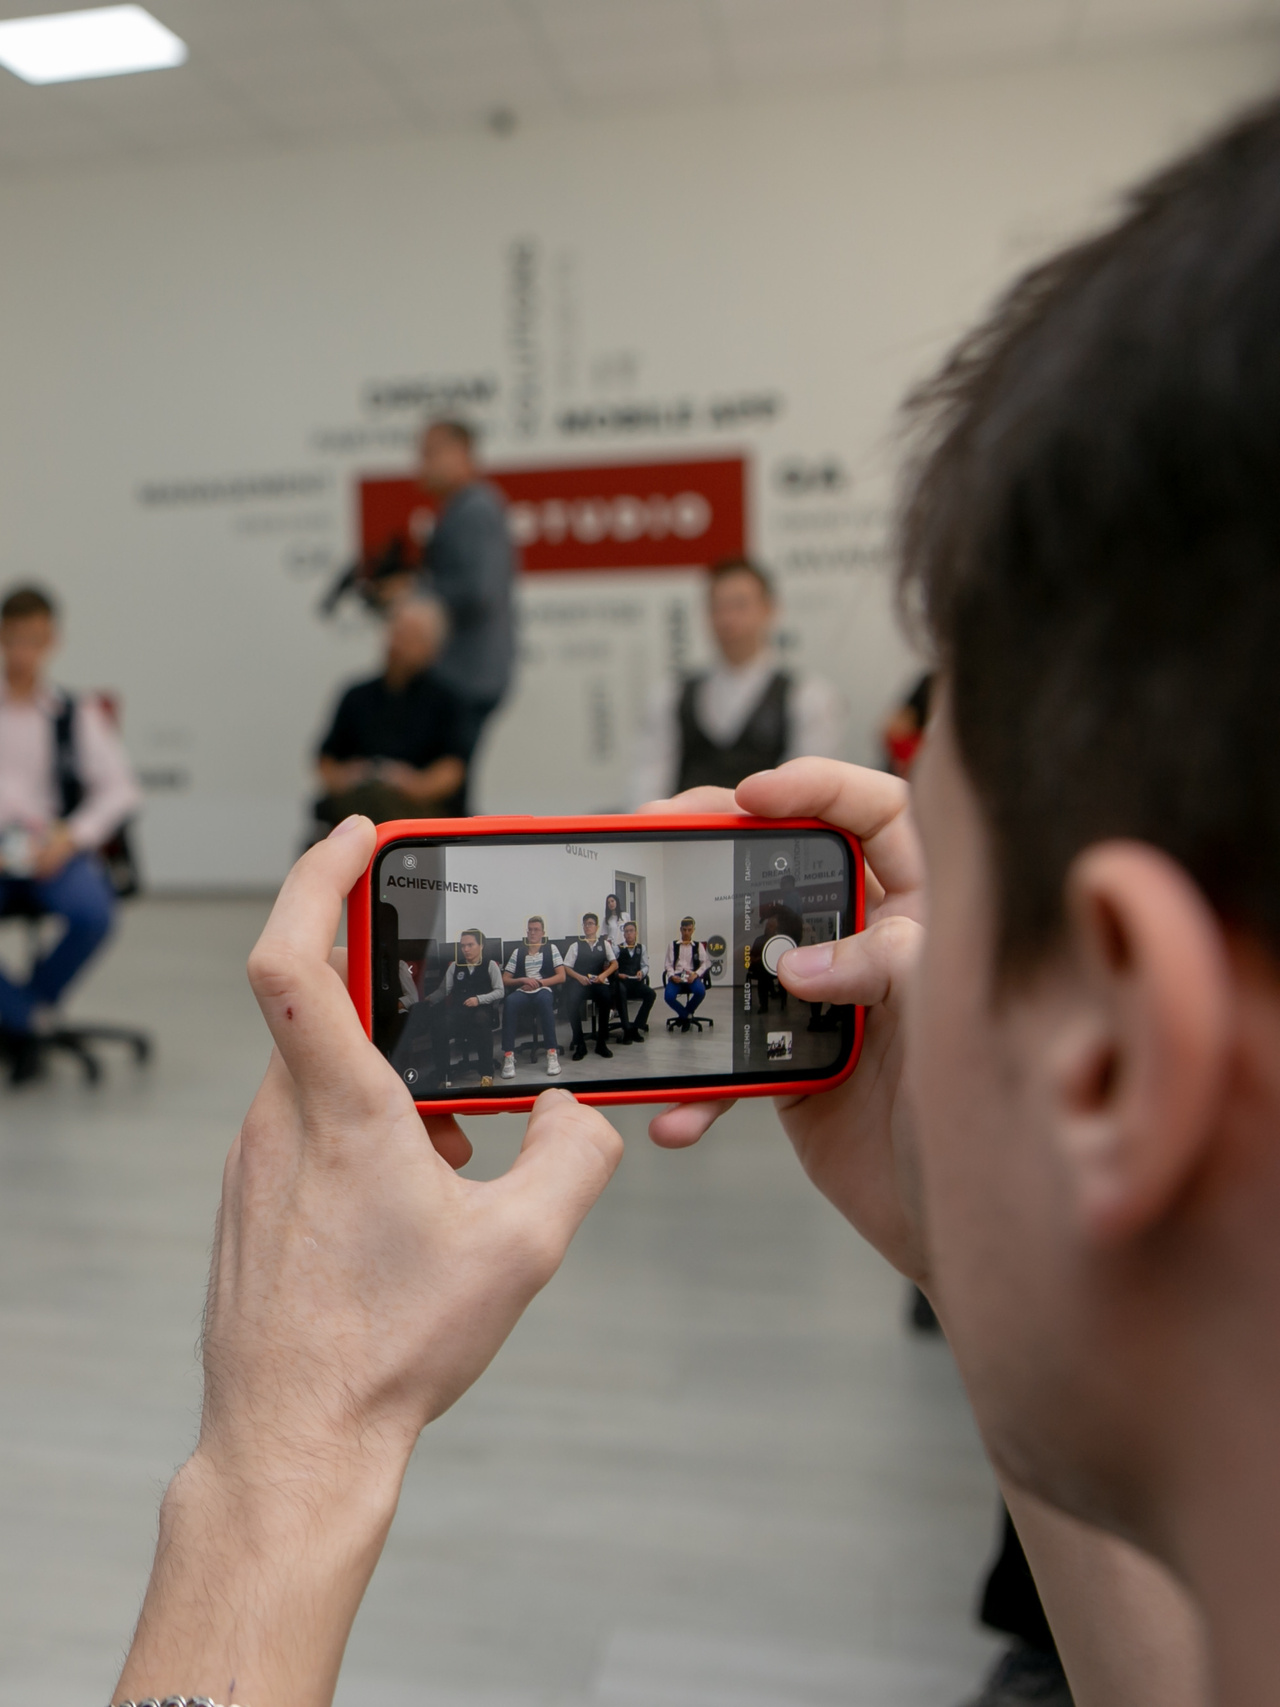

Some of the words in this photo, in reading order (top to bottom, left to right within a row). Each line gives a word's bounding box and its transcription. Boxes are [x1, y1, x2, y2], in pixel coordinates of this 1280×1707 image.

[565, 844, 599, 861] QUALITY
[813, 860, 824, 870] IT
[762, 868, 791, 879] DREAM
[804, 870, 836, 881] MOBILE
[386, 875, 479, 895] ACHIEVEMENTS
